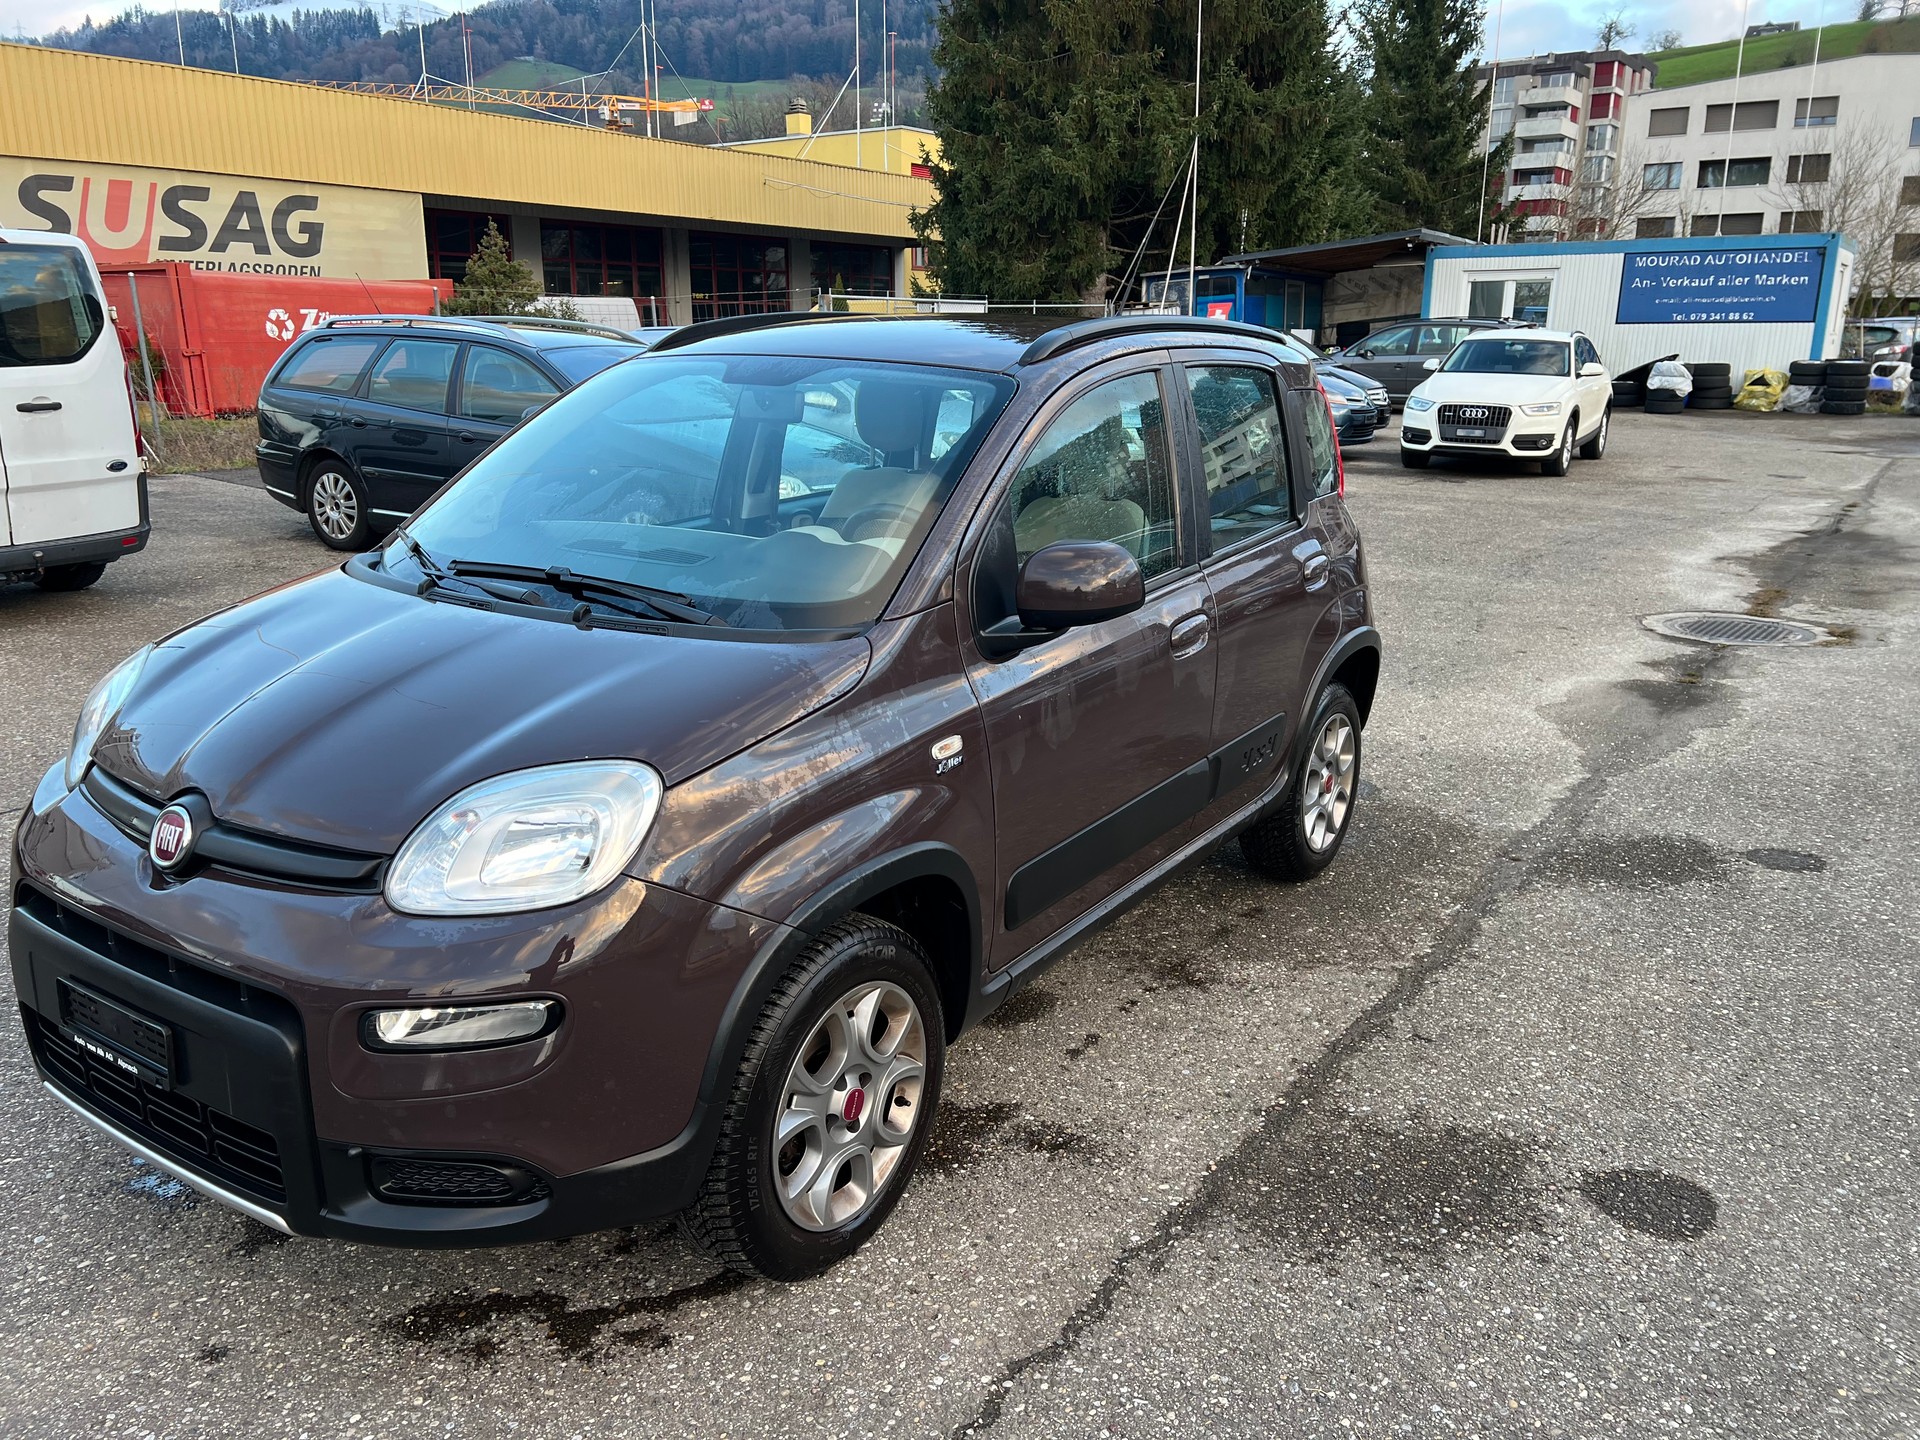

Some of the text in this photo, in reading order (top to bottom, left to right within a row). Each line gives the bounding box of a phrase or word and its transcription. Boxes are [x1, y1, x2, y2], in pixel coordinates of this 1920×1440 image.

[18, 174, 324, 258] SUSAG
[1634, 252, 1812, 267] MOURAD AUTOHANDEL
[1631, 274, 1809, 288] An- Verkauf aller Marken
[1672, 313, 1688, 321] Tel.
[1690, 313, 1707, 321] 079
[1728, 312, 1740, 320] 88
[1742, 312, 1754, 320] 62
[157, 822, 183, 853] FIAT
